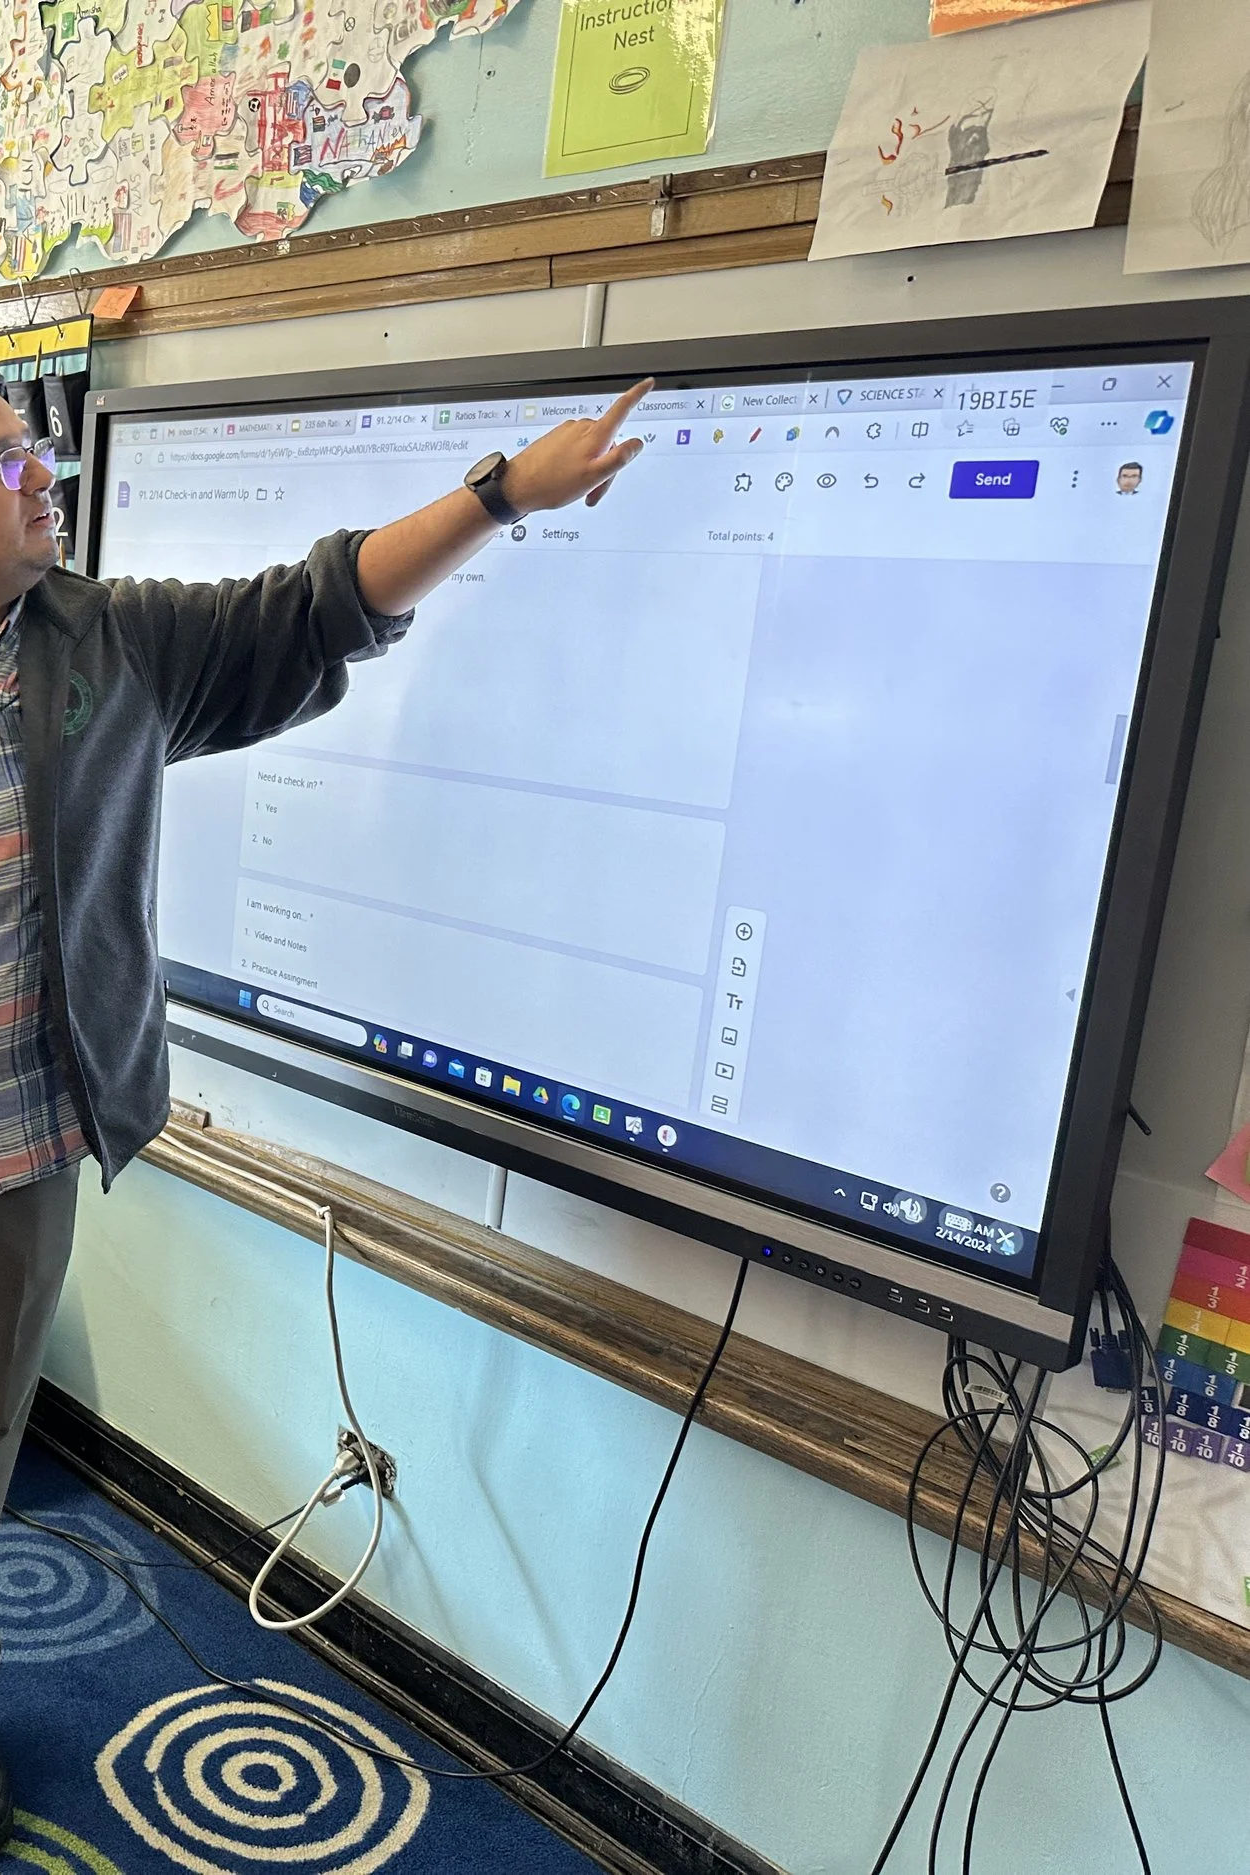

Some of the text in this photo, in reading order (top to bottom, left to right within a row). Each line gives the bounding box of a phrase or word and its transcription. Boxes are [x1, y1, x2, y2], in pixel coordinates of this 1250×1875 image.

[613, 26, 654, 50] Nest
[743, 396, 763, 407] New
[860, 388, 904, 401] SCIENCE
[455, 411, 476, 421] Ratios
[542, 406, 577, 416] Welcome
[50, 405, 63, 438] 6
[975, 472, 1012, 486] Send
[149, 490, 164, 500] 2/14
[164, 489, 199, 500] Check-in
[202, 489, 213, 500] and
[214, 489, 237, 500] Warm
[237, 489, 249, 501] Up
[52, 507, 68, 536] 2
[512, 527, 525, 538] 30
[542, 528, 579, 541] Settings
[707, 531, 774, 543] Total points: 4
[452, 573, 486, 584] my own.
[257, 771, 276, 783] Need
[284, 776, 305, 788] check
[306, 780, 318, 790] in?
[265, 803, 278, 814] Yes
[262, 835, 273, 845] No
[250, 901, 262, 910] am
[263, 902, 291, 920] working
[254, 930, 272, 943] Video
[273, 936, 286, 947] and
[287, 940, 307, 952] Notes
[251, 962, 277, 977] Practice
[279, 970, 318, 989] Assingment
[273, 1005, 295, 1019] Search
[974, 1223, 995, 1239] AM
[935, 1226, 992, 1254] 2/14/2024
